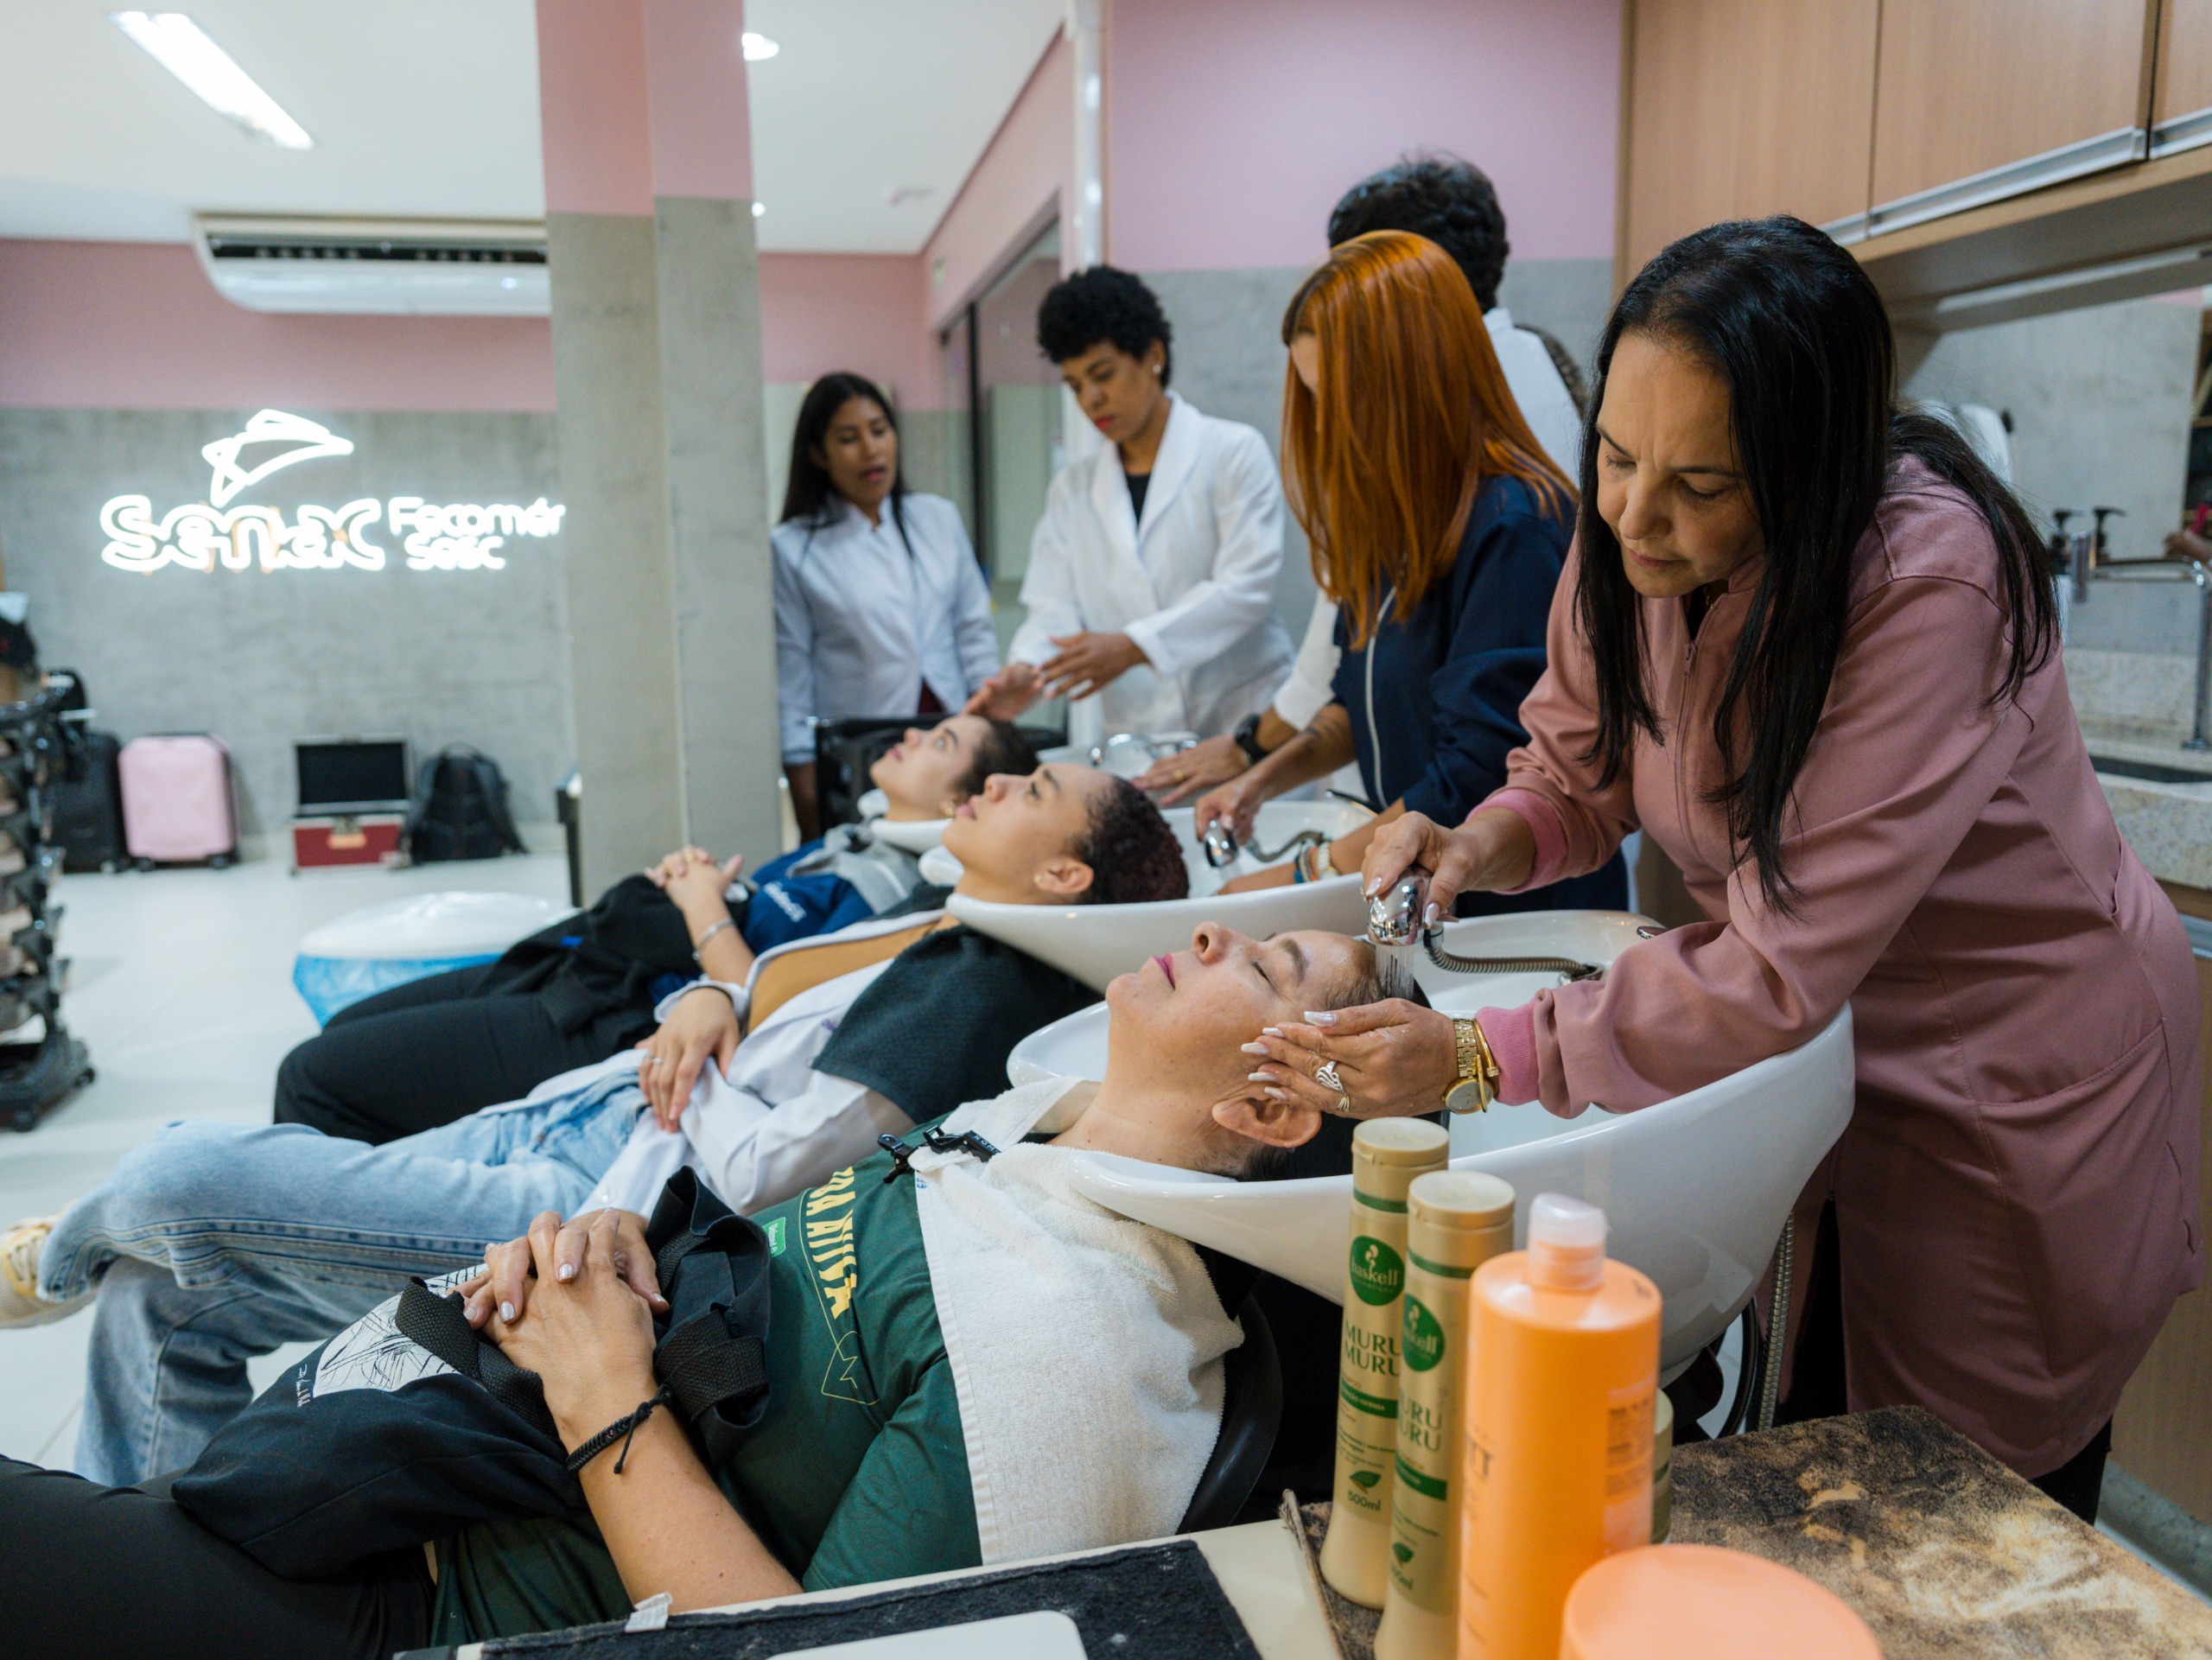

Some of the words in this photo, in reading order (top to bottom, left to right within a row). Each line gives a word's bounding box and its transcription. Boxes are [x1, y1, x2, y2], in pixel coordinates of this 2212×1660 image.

[100, 494, 385, 571] Senac
[388, 497, 567, 537] Fecomér
[1351, 1255, 1399, 1286] haskell
[1399, 1389, 1443, 1432] URU
[1398, 1412, 1441, 1453] URU
[1348, 1489, 1382, 1511] 500ml
